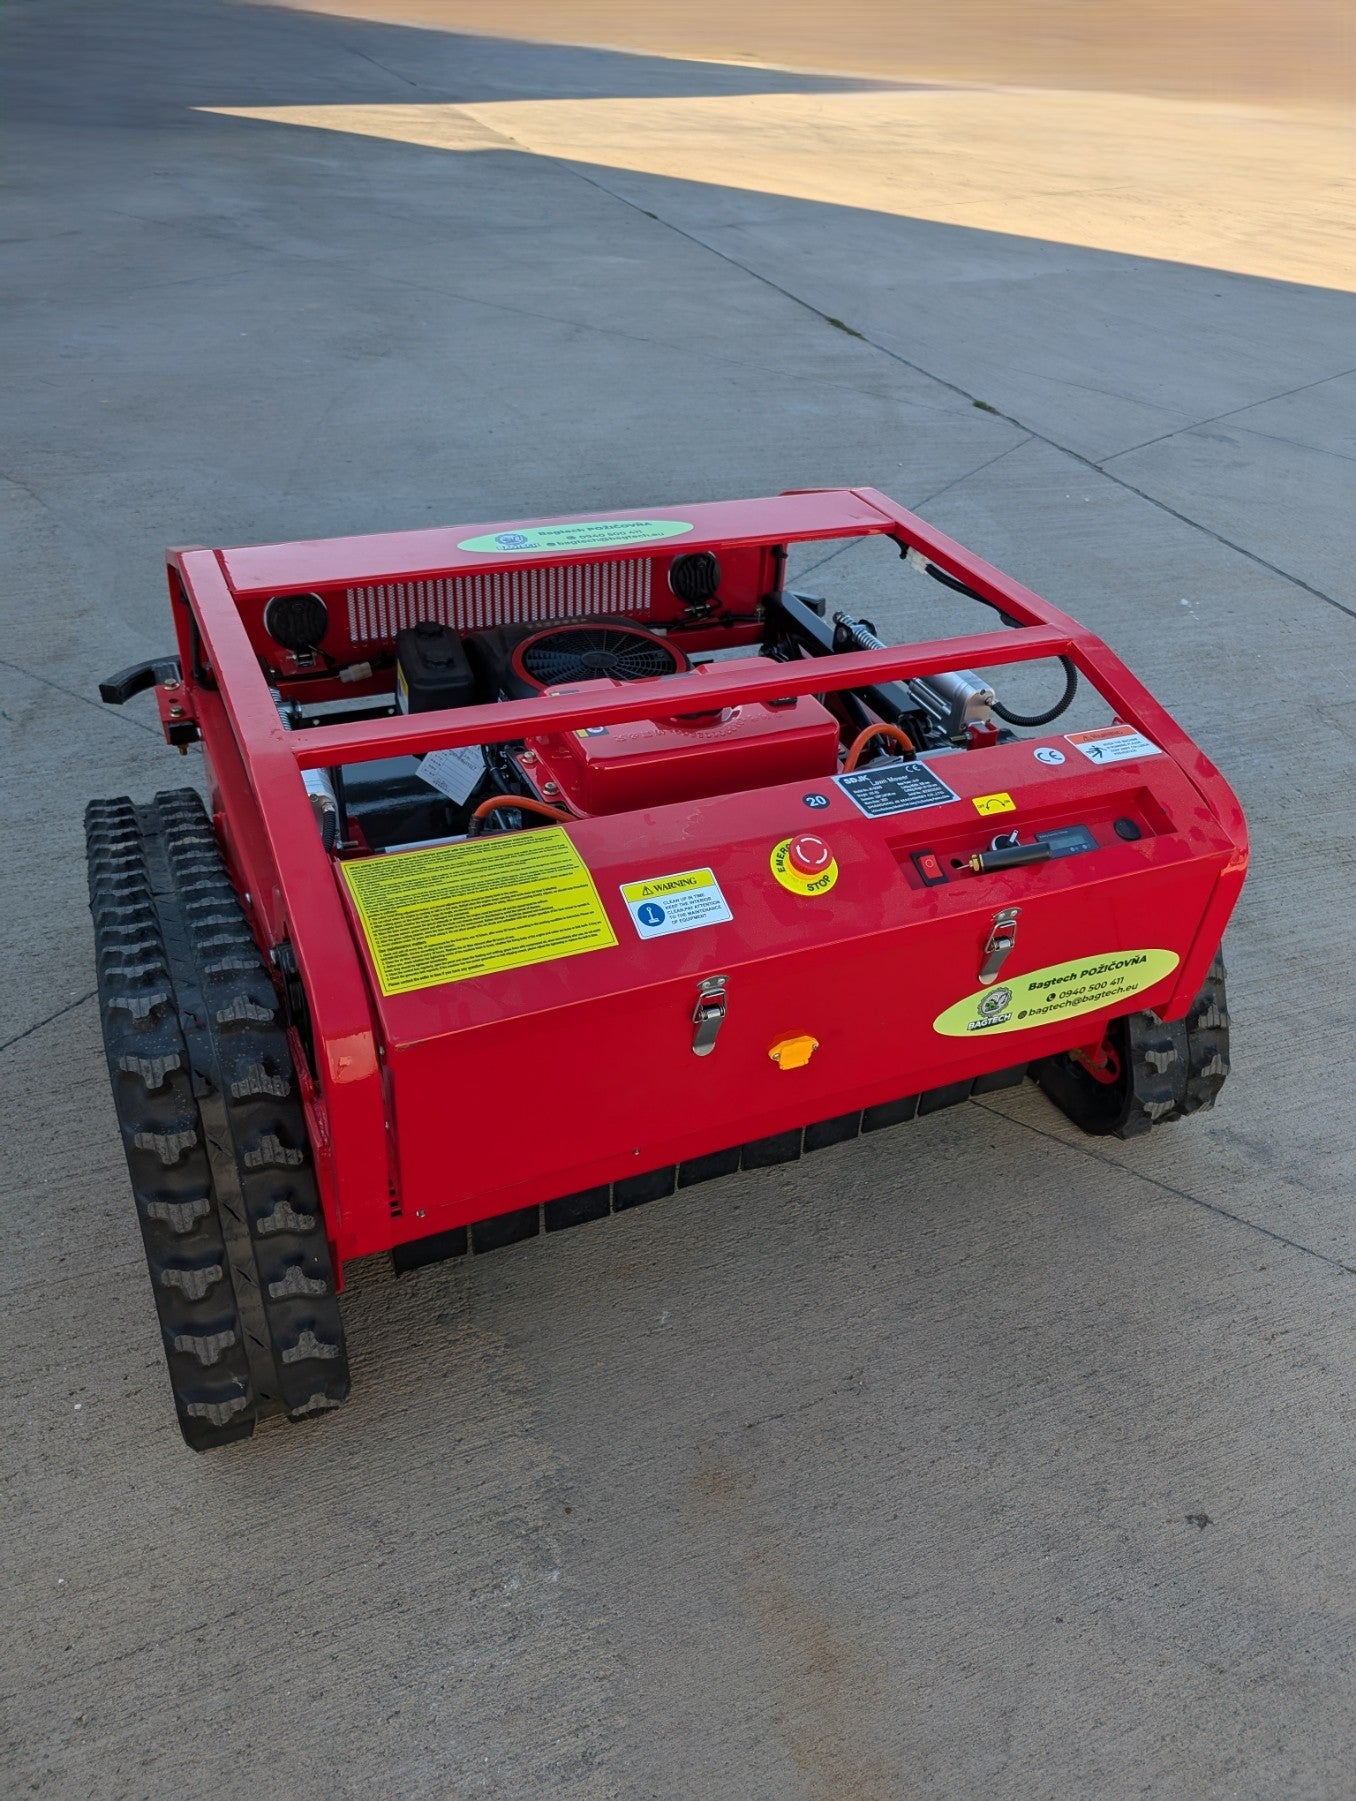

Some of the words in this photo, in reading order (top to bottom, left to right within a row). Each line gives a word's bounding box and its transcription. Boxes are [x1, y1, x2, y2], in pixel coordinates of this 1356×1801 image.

[538, 528, 585, 537] Bagtech
[805, 795, 827, 807] 20
[653, 877, 697, 891] WARNING
[806, 875, 831, 891] STOP
[688, 905, 721, 915] MAINTENANCE
[694, 901, 720, 909] ATTENTION
[679, 914, 707, 923] EQUIPMENT
[1028, 972, 1077, 991] Bagtech
[1080, 955, 1147, 979] POŽIČOVŇA
[1059, 987, 1086, 999] 0940
[1088, 981, 1108, 992] 500
[1109, 976, 1124, 986] 411
[1028, 983, 1139, 1016] bagtech@bagtech.eu
[967, 1012, 1012, 1030] BAGTECH
